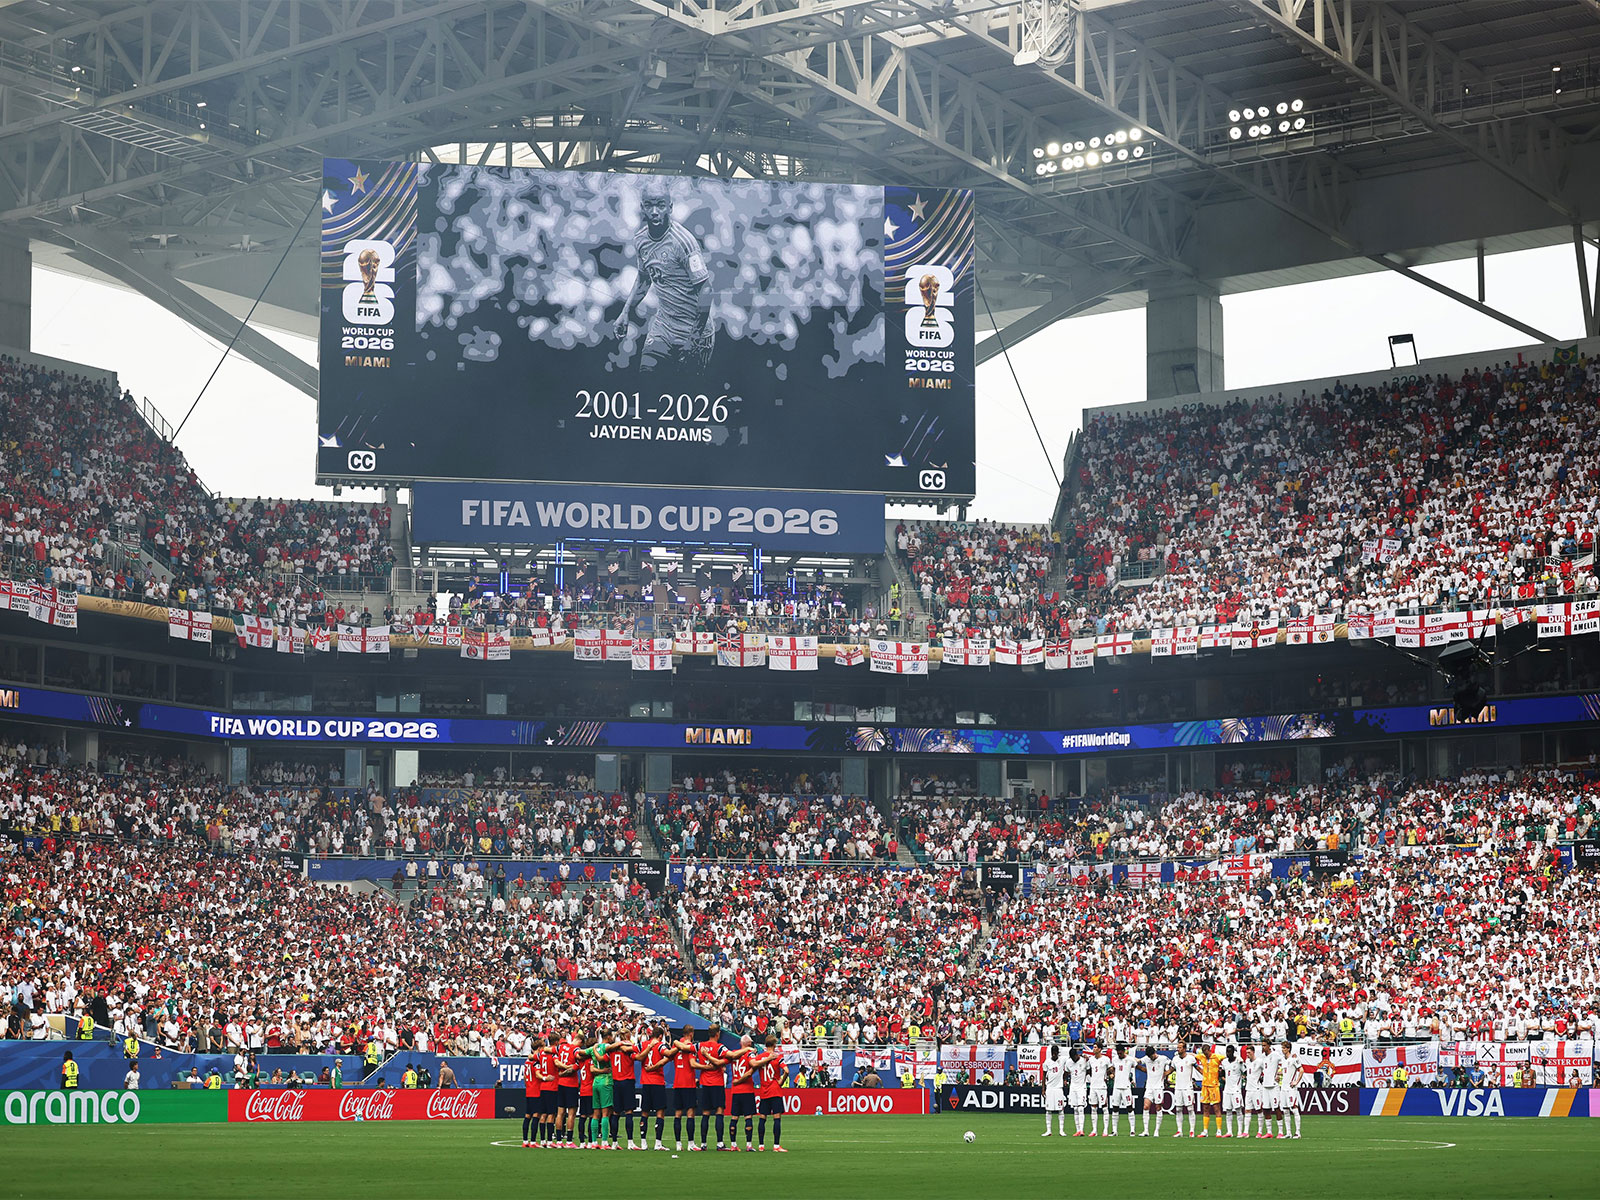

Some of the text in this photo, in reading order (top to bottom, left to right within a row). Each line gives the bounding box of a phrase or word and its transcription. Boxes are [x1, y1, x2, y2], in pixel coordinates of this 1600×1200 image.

[357, 307, 381, 317] FIFA
[342, 327, 395, 337] WORLD CUP
[919, 331, 942, 341] FIFA
[341, 336, 395, 350] 2026
[905, 349, 955, 359] WORLD CUP
[344, 356, 391, 369] MIAMI
[905, 360, 955, 373] 2026
[908, 377, 952, 390] MIAMI
[574, 390, 729, 424] 2001-2026
[589, 425, 713, 443] JAYDEN ADAMS
[350, 453, 374, 469] CC
[921, 472, 944, 488] CC
[461, 499, 840, 535] FIFA WORLD CUP 2026
[1575, 601, 1597, 611] SAFC
[1548, 612, 1588, 623] DURHAM
[1240, 619, 1271, 629] WOVES
[1372, 619, 1386, 627] CITY
[1457, 620, 1484, 630] RAUNDS
[1573, 621, 1598, 632] AMELIA
[192, 631, 208, 639] NFFC
[1400, 627, 1426, 635] RUNNING
[1427, 625, 1445, 633] MARE
[1540, 626, 1562, 634] AMBER
[366, 635, 390, 643] ROVERS
[429, 636, 443, 644] CM2
[1154, 637, 1185, 645] ARSENAL
[1237, 639, 1248, 647] AY
[1261, 636, 1273, 644] WE
[1401, 636, 1414, 644] USA
[1429, 634, 1445, 643] 2026
[871, 651, 918, 661] PORTSMOUTH
[1429, 704, 1497, 726] MIMI
[210, 715, 440, 740] FIFA WORLD CUP 2026
[685, 727, 752, 745] MIAMI
[1062, 731, 1132, 749] #FIFAWorldCup
[1299, 1047, 1353, 1057] BEECHY'S
[1505, 1047, 1528, 1055] LENNY
[541, 1057, 551, 1075] 5
[615, 1055, 623, 1073] 9
[941, 1061, 1004, 1070] MIDDLESBROUGH
[1019, 1062, 1041, 1071] Jimmy
[1571, 1057, 1590, 1066] CITY
[499, 1064, 525, 1082] FIFA
[580, 1064, 588, 1081] 6
[761, 1063, 776, 1082] 10
[1366, 1063, 1425, 1078] BLACKOOL
[827, 1090, 895, 1114] Lenovo
[962, 1089, 1006, 1109] ADI
[1100, 1094, 1105, 1102] 5
[1431, 1088, 1506, 1117] VISA
[4, 1090, 141, 1124] aramco
